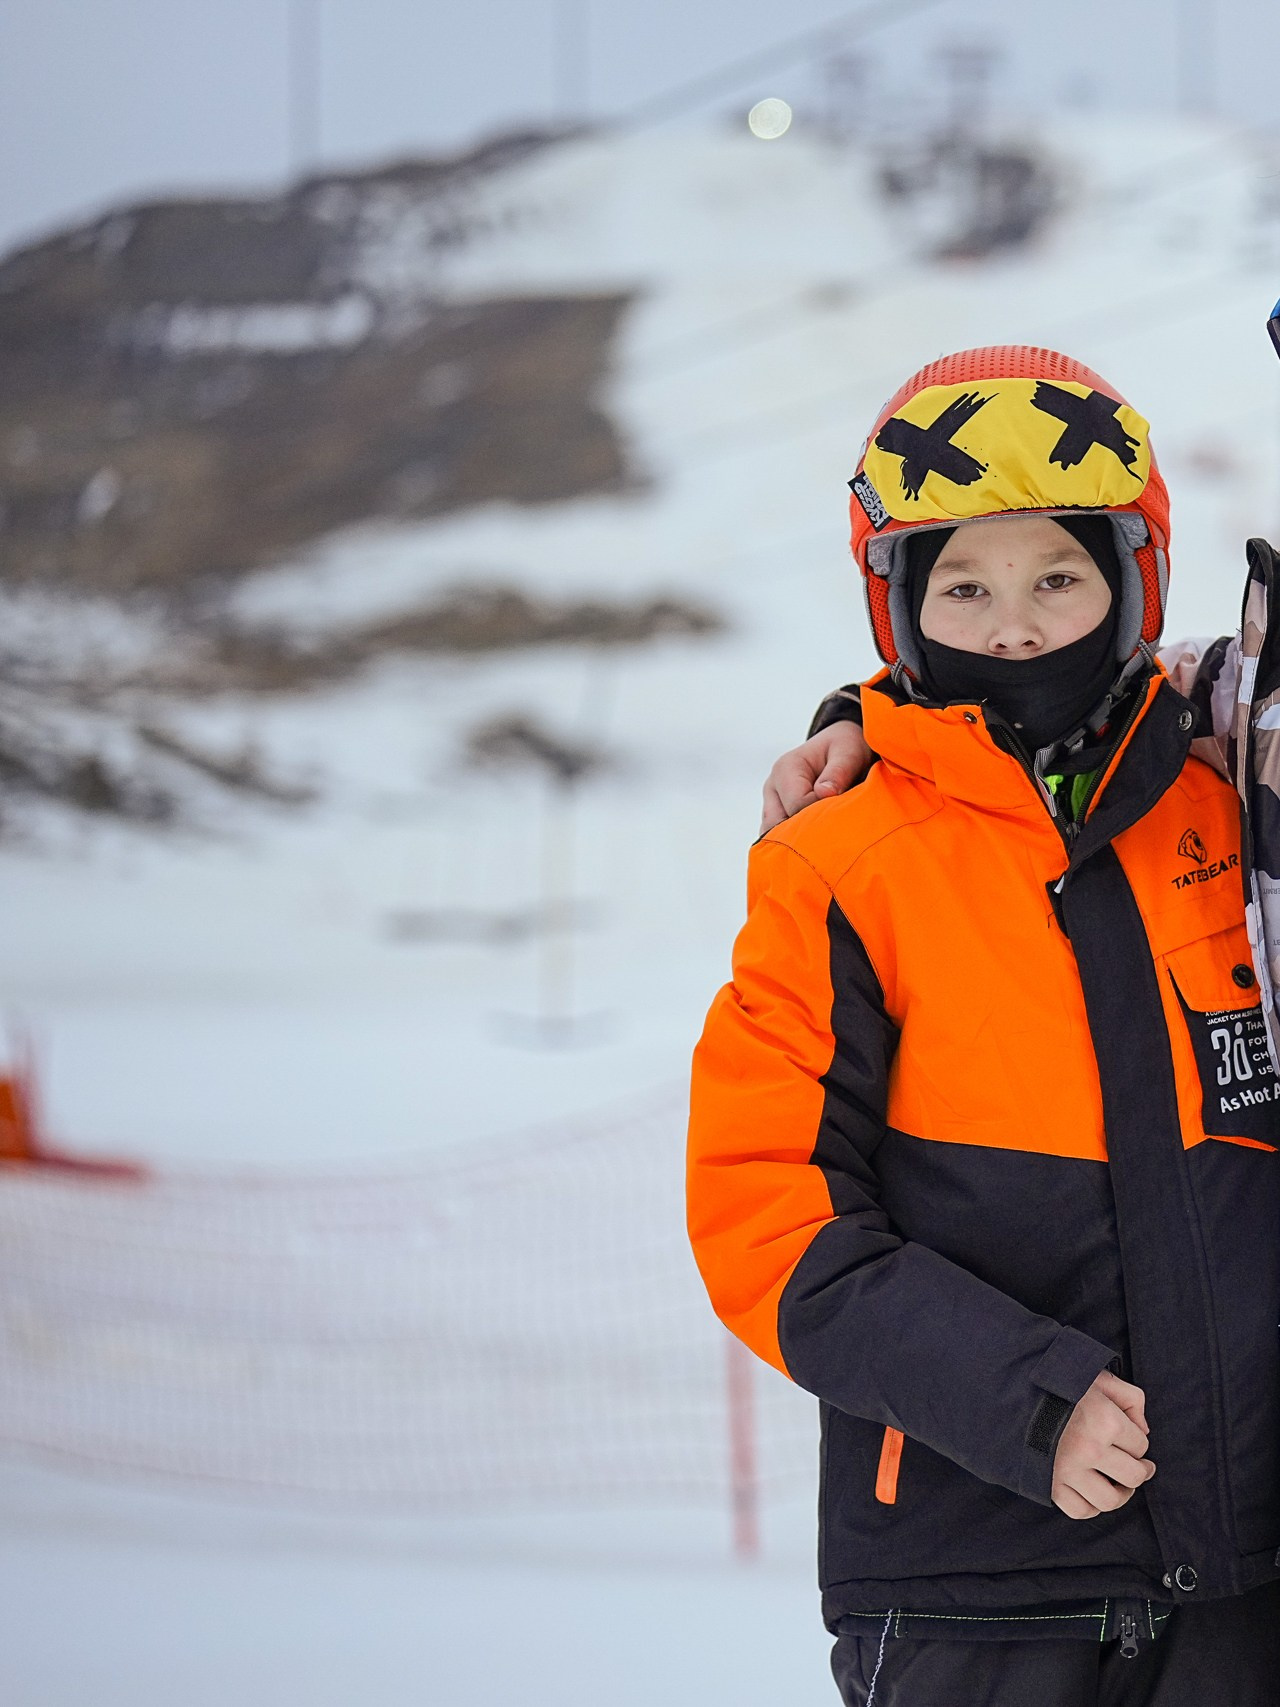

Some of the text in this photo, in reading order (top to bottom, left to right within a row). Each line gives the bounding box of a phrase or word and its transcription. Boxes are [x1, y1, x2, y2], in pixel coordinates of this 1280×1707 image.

[1171, 853, 1239, 890] TATEBEAR
[1220, 1096, 1240, 1113] As
[1239, 1086, 1271, 1107] Hot
